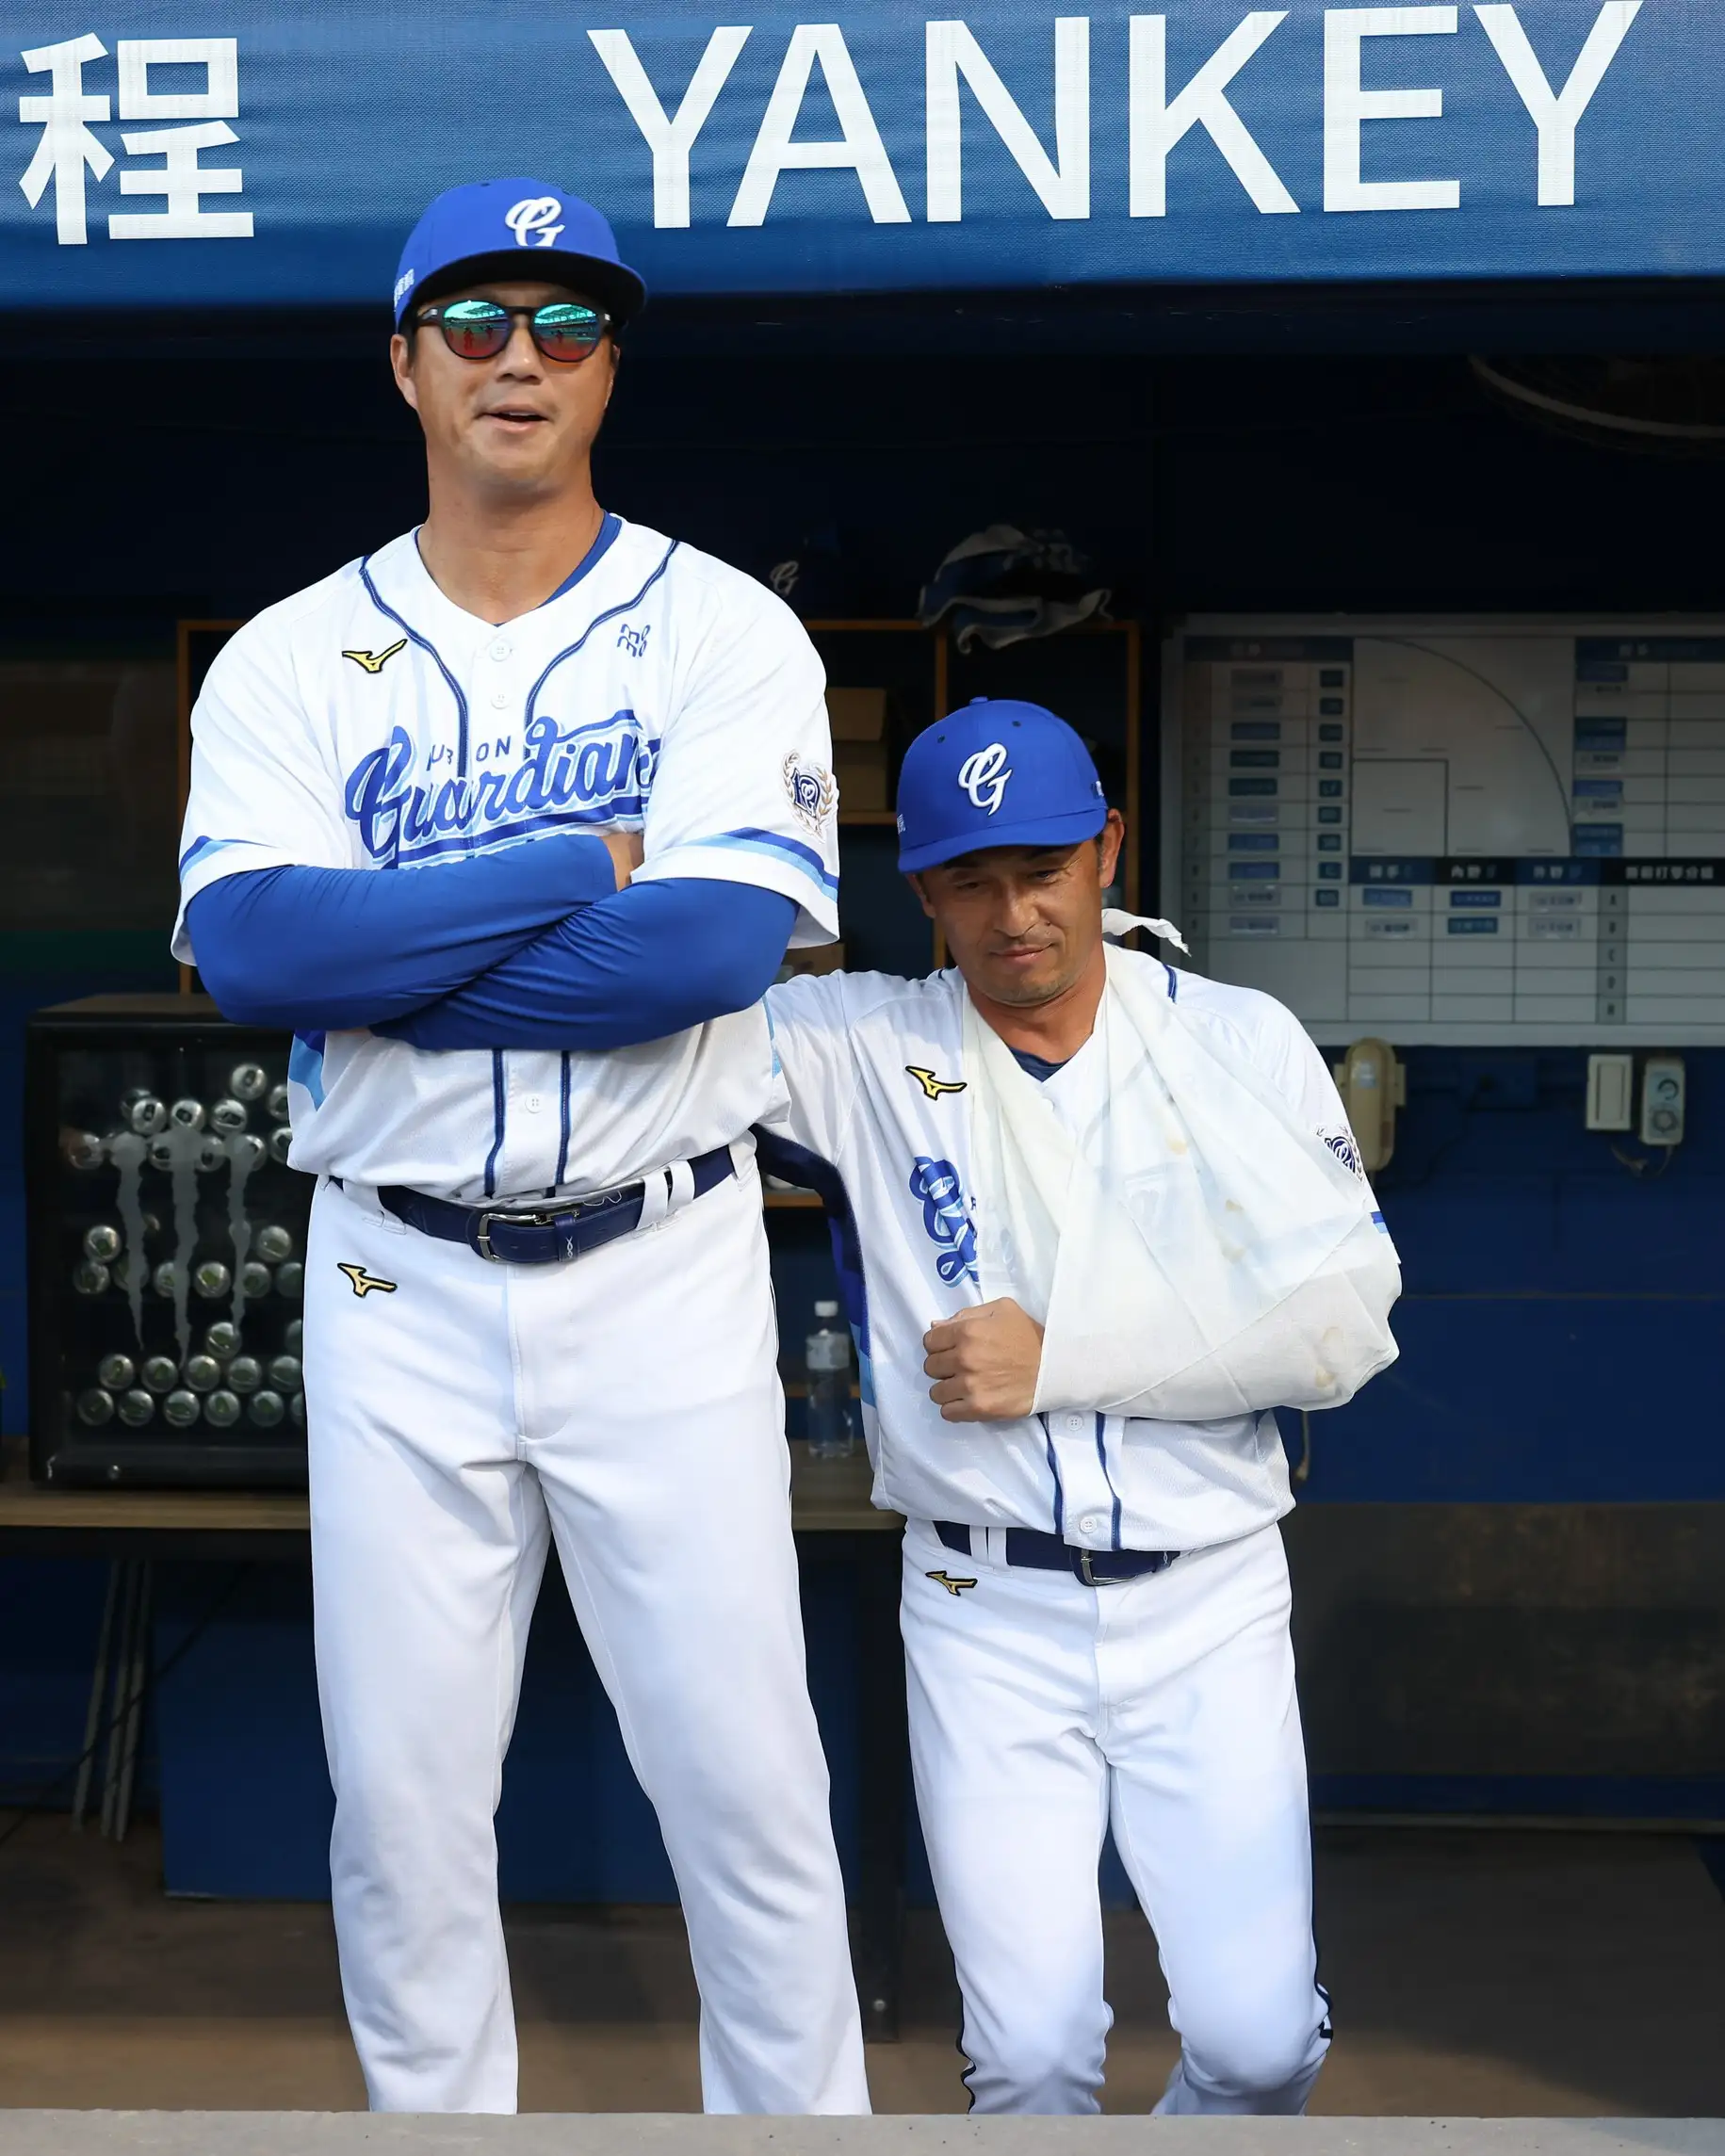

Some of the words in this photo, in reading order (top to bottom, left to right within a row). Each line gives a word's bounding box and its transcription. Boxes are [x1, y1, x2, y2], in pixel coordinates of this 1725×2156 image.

[19, 33, 253, 245] 程
[587, 0, 1643, 229] YANKEY
[345, 714, 661, 869] Guardian
